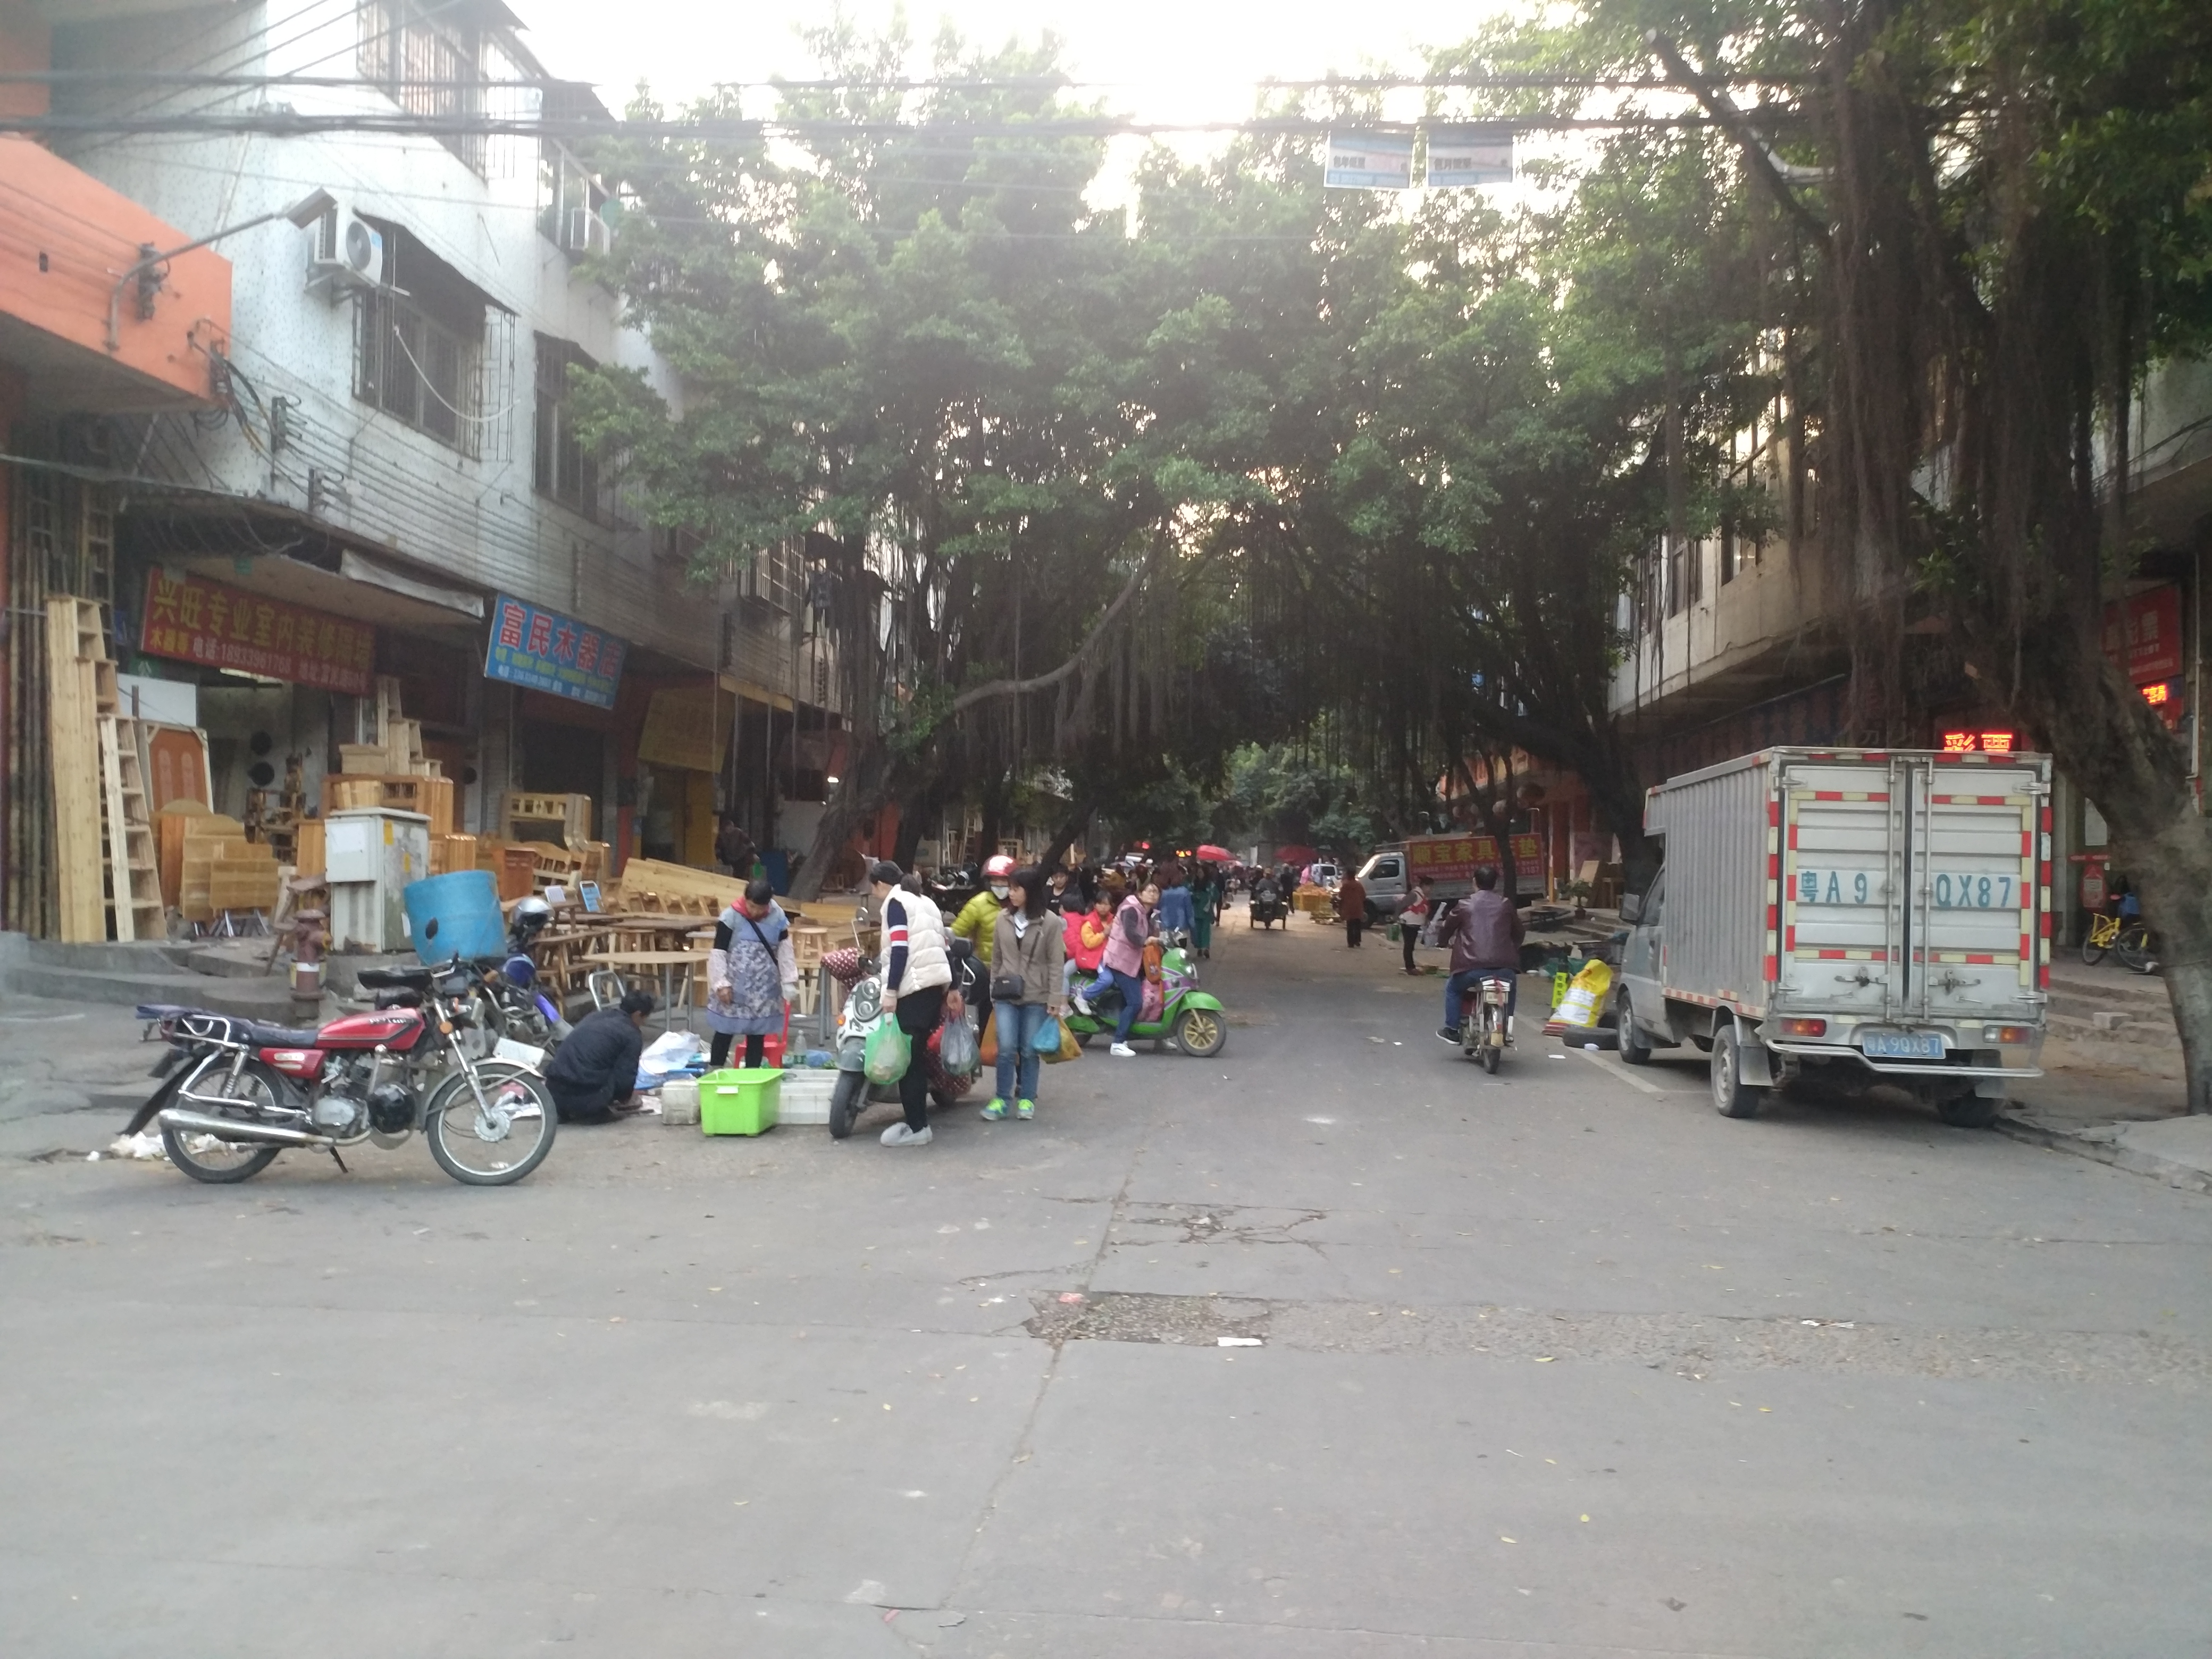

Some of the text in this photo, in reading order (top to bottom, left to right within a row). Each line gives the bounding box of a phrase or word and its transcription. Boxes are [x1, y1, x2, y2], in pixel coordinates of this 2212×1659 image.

[499, 602, 622, 680] 富民木器店
